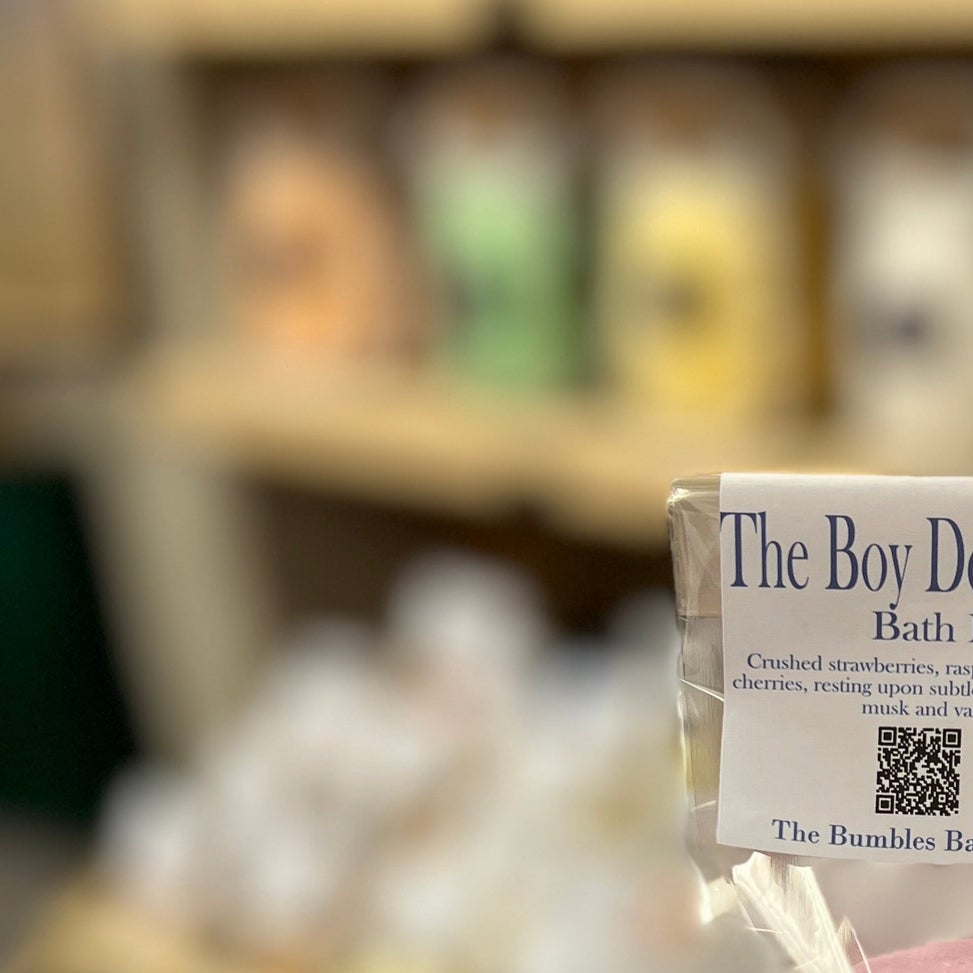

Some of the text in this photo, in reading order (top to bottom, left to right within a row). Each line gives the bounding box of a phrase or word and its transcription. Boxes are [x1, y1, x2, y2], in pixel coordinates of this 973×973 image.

[719, 510, 810, 590] The
[824, 514, 913, 611] Boy
[872, 609, 957, 643] Bath
[746, 652, 823, 672] Crushed
[828, 656, 940, 678] strawberries,
[732, 673, 809, 694] cherries,
[813, 680, 873, 698] resting
[877, 683, 924, 698] upon
[861, 699, 910, 716] musk
[914, 702, 948, 717] and
[771, 817, 820, 844] The
[828, 823, 937, 852] Bumbles
